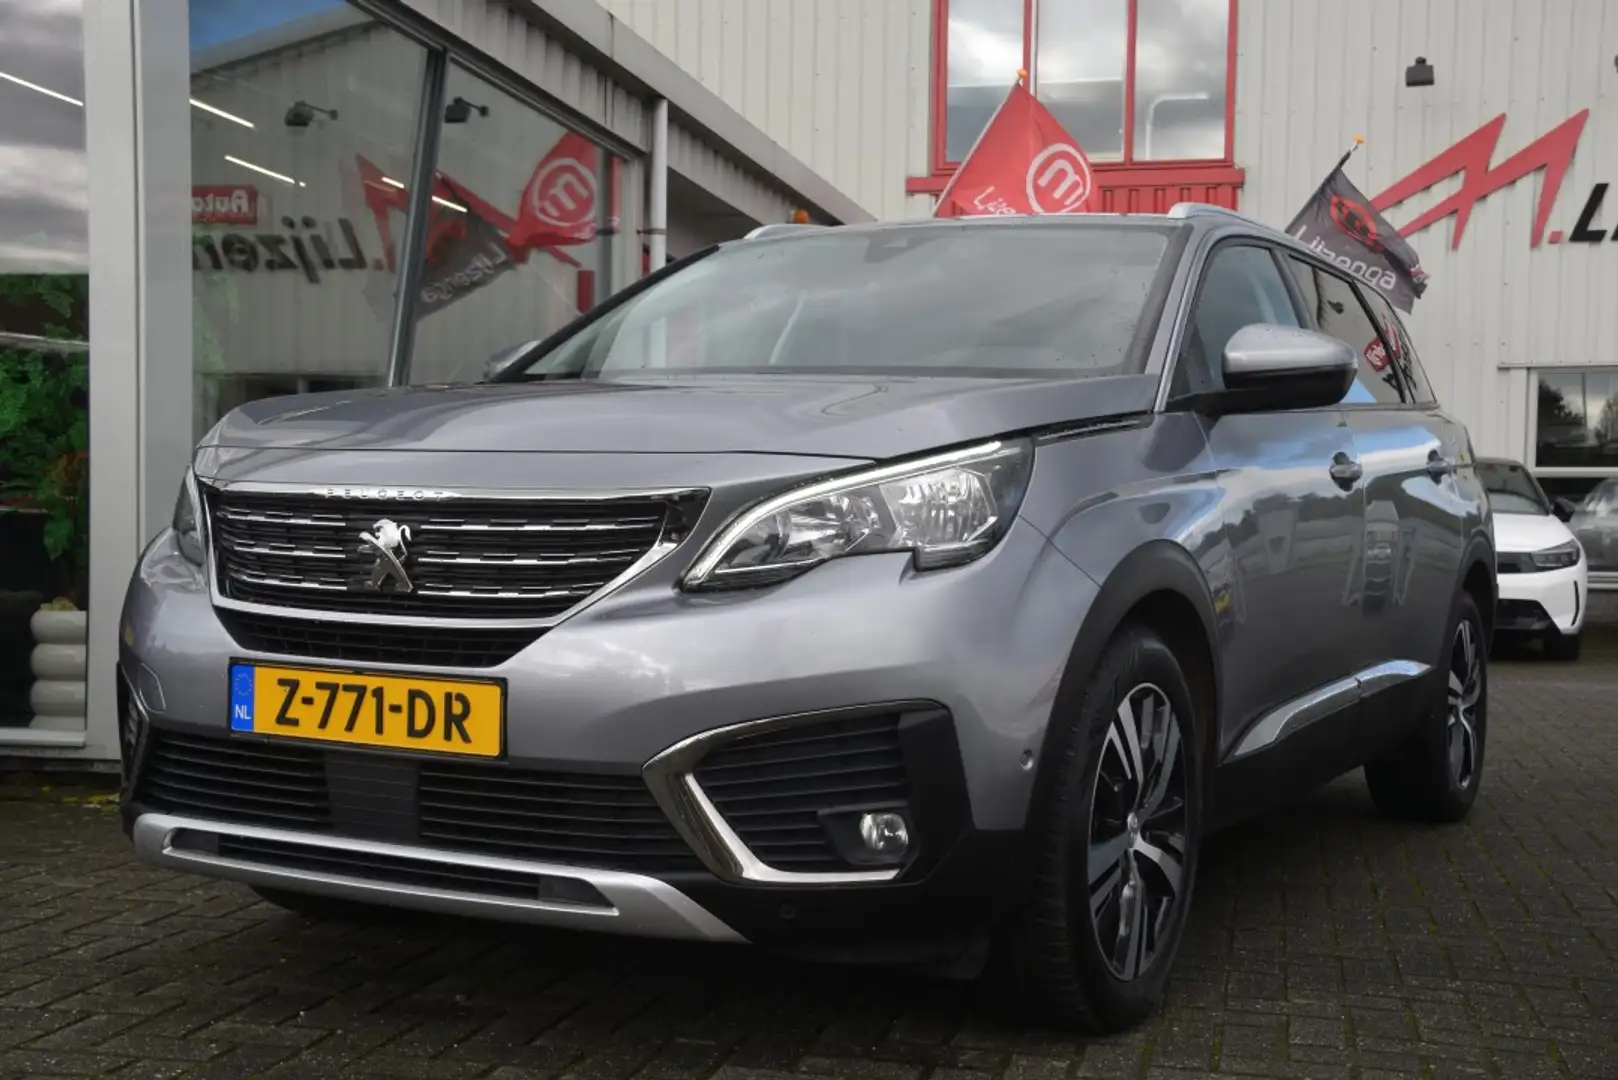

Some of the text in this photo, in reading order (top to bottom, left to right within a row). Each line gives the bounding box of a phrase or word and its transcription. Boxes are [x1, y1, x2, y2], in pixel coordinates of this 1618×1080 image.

[324, 487, 443, 501] PEUGEOT
[235, 705, 252, 720] NL
[275, 677, 472, 744] Z-771-DR
